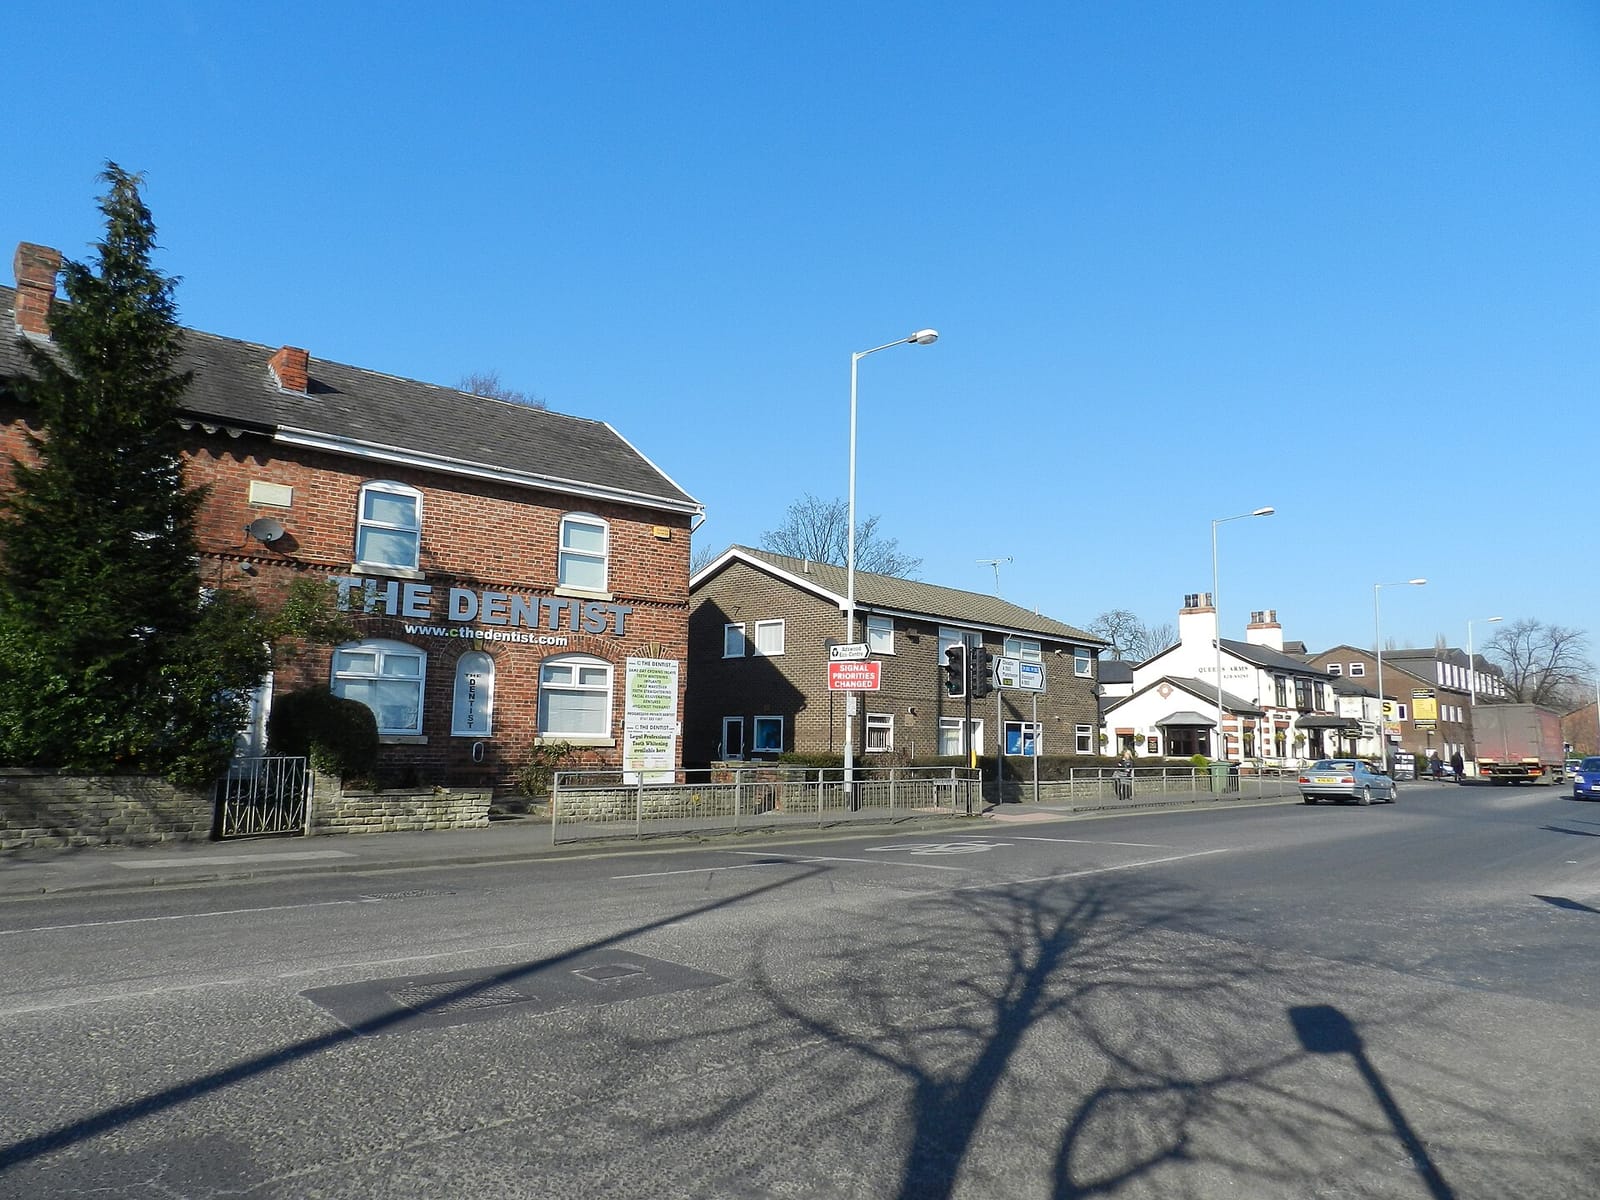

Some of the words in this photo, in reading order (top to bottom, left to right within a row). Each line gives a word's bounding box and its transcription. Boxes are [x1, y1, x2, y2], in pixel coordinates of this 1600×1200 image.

[328, 575, 432, 619] THE
[448, 587, 633, 635] DENTIST
[404, 624, 568, 646] www.cthedentist.com
[839, 664, 869, 672] SIGNAL
[832, 672, 876, 680] PRIORITIES
[834, 680, 873, 688] CHANGED
[467, 679, 476, 728] DENTIST
